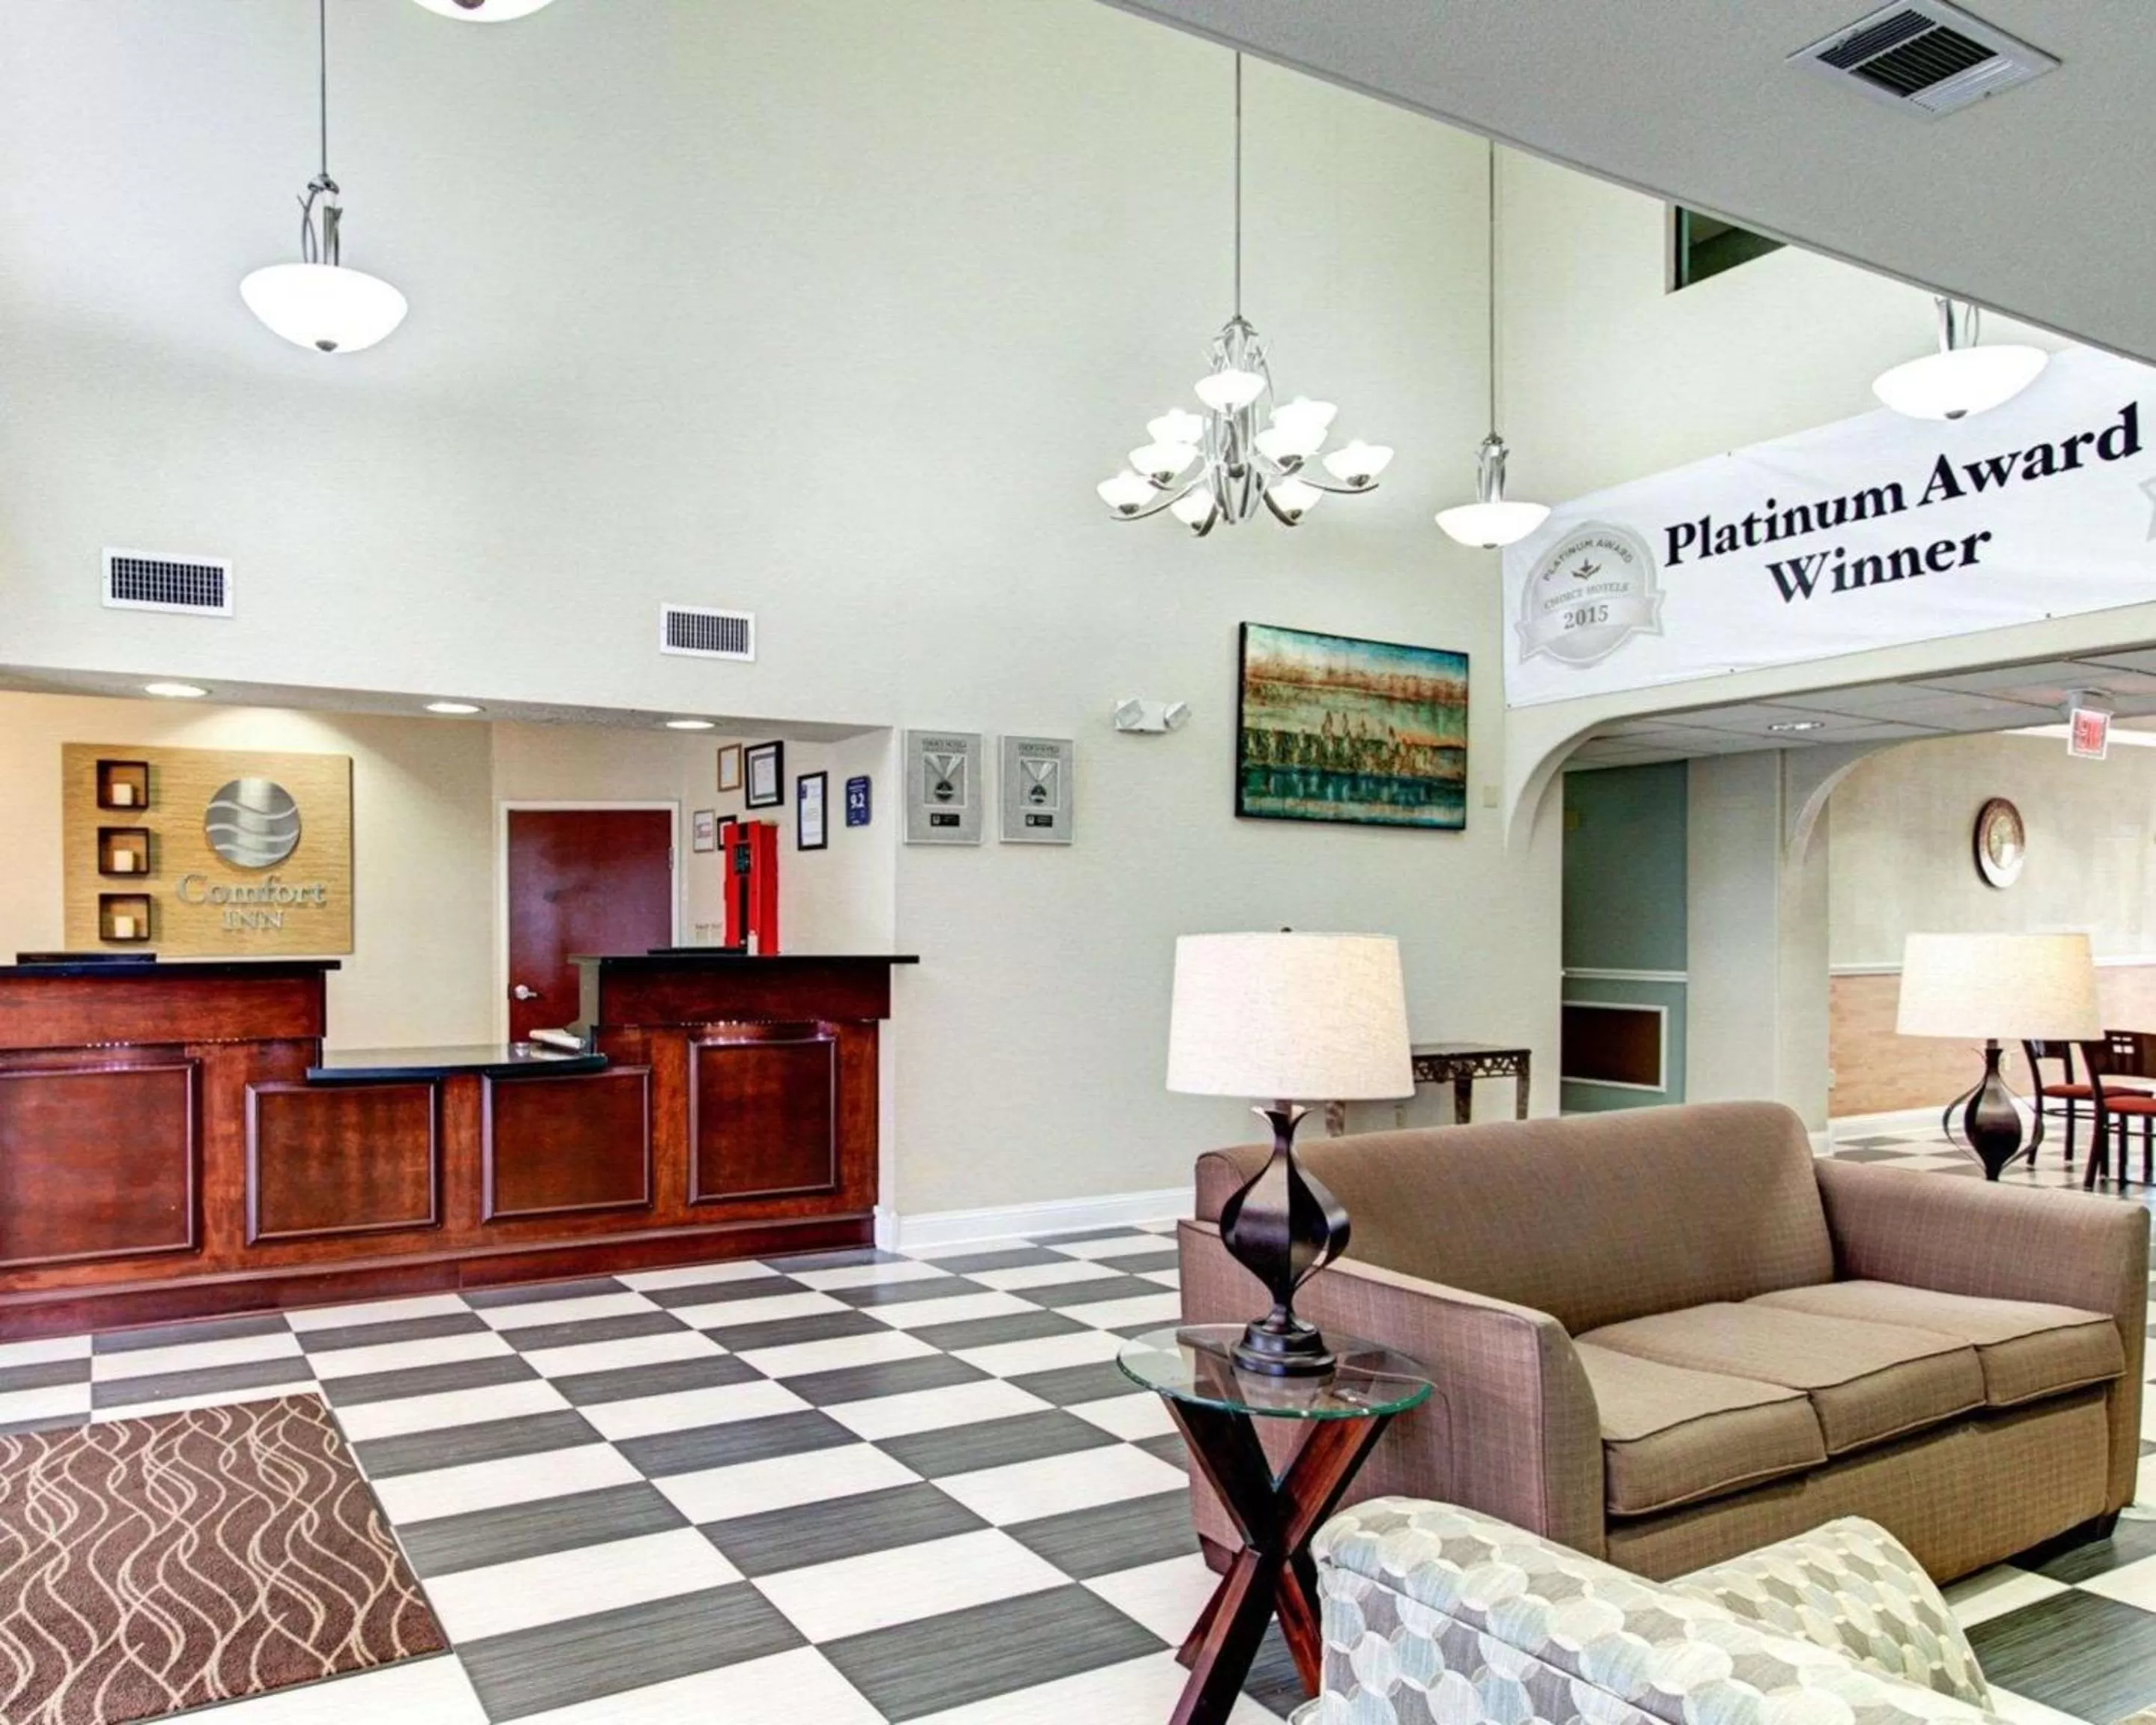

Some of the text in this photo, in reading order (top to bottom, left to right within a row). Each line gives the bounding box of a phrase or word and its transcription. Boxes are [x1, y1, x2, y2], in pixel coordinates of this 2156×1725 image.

[1664, 401, 2142, 567] Platinum Award
[1543, 538, 1633, 582] PLATINUM AWARD
[1765, 531, 1991, 602] Winner
[1564, 605, 1609, 630] 2015
[175, 873, 328, 910] Comfort
[222, 909, 286, 931] INN
